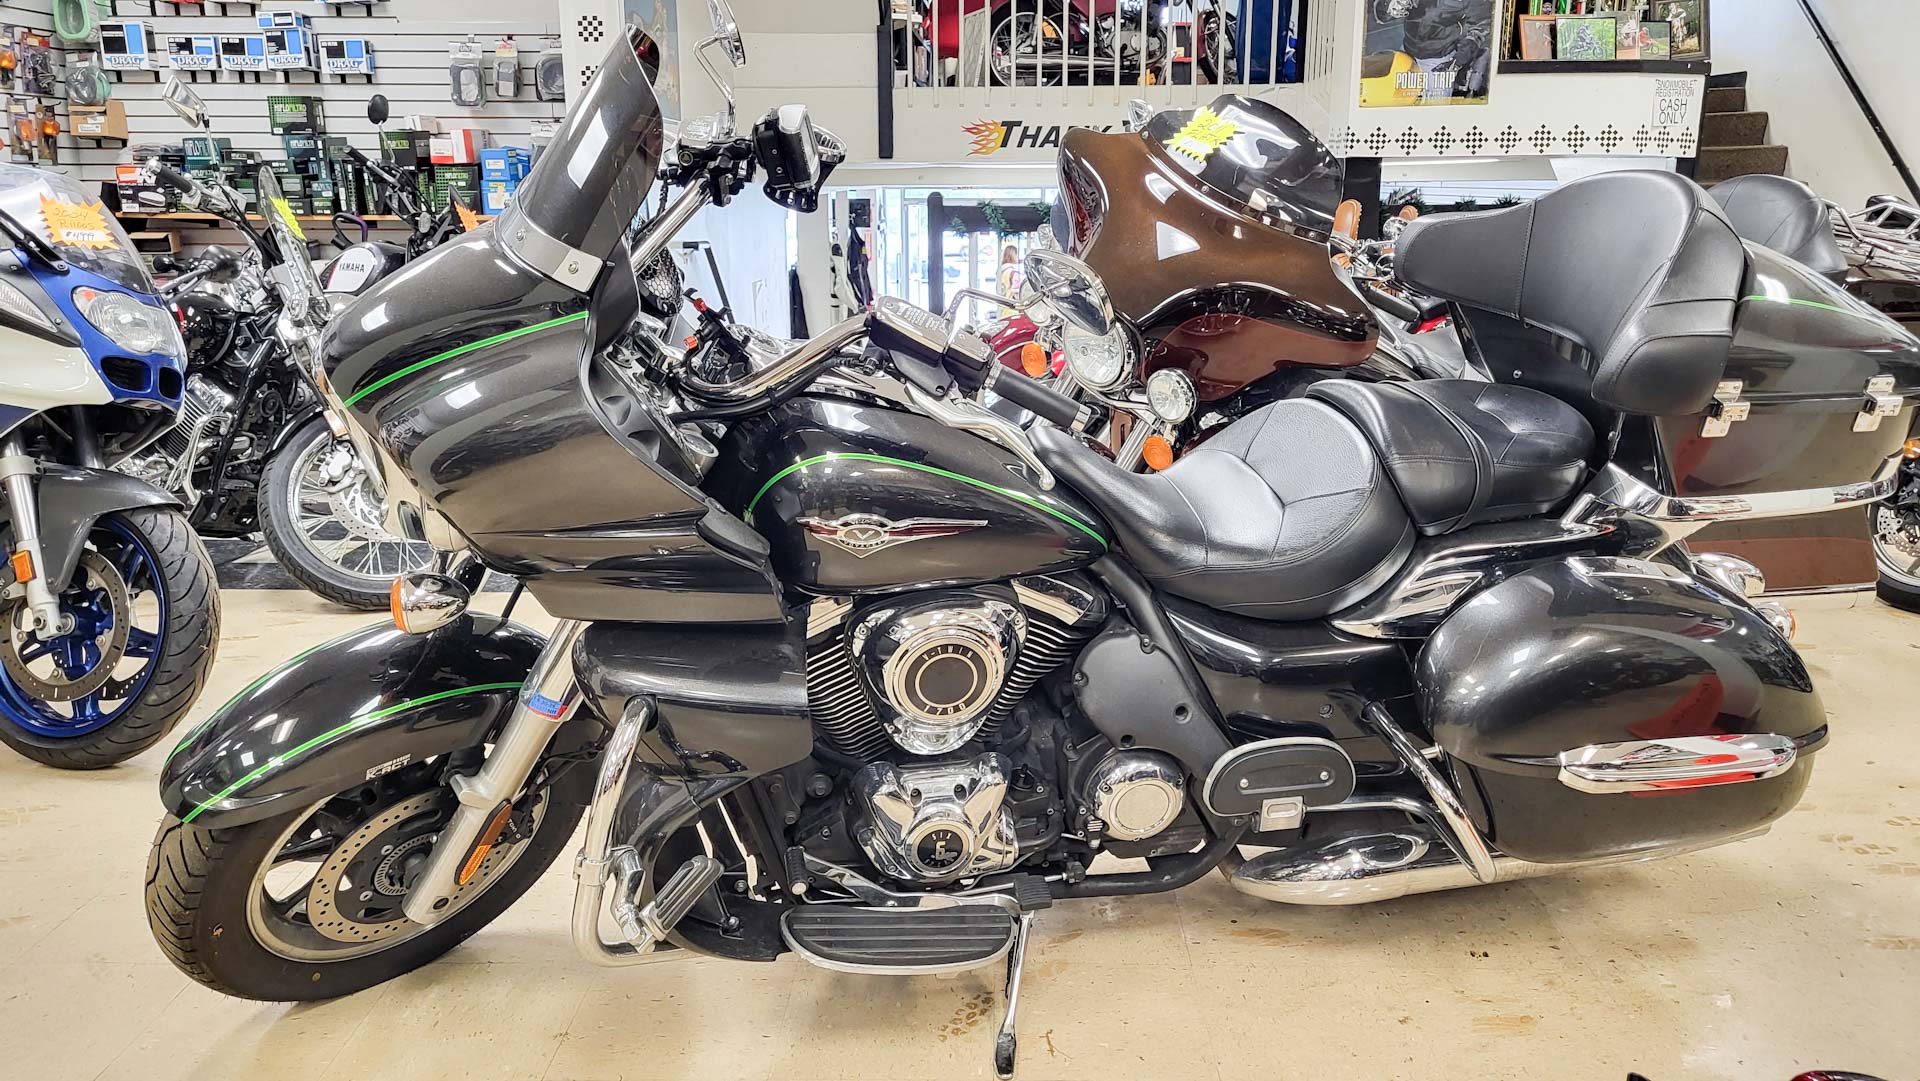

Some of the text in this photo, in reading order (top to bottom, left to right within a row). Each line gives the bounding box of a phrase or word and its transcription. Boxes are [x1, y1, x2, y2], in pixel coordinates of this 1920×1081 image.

[112, 56, 140, 64] DRAG
[178, 56, 207, 64] DRAG
[230, 56, 259, 65] DRAG
[275, 56, 299, 64] DRAG
[330, 59, 359, 68] DRAG
[1396, 72, 1455, 89] POWER TRIP
[1656, 88, 1694, 97] REGISTRATION
[1660, 98, 1687, 111] CASH
[1659, 111, 1686, 124] ONLY
[340, 262, 364, 272] YAMAHA
[921, 645, 973, 661] V-TWIN
[923, 702, 966, 716] 1700
[931, 832, 952, 840] SIX
[935, 841, 946, 860] 6
